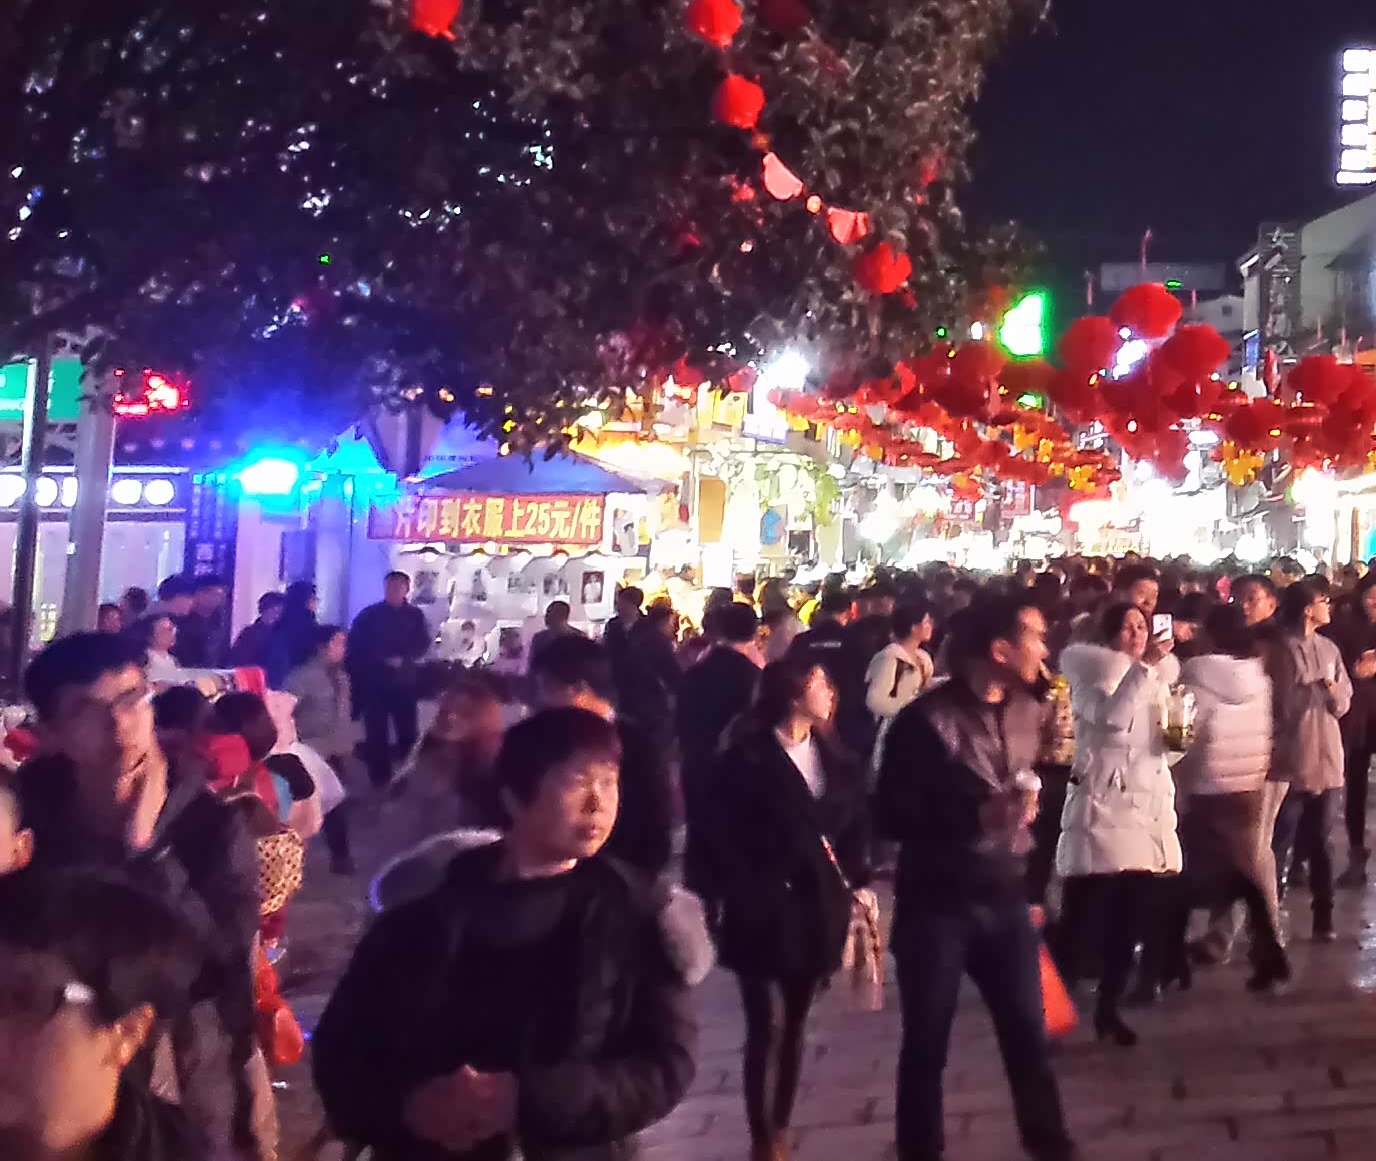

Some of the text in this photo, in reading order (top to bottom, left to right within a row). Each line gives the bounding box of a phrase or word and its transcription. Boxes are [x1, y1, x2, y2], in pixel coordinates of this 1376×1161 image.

[370, 496, 602, 538] 片印到衣服上25元/件
